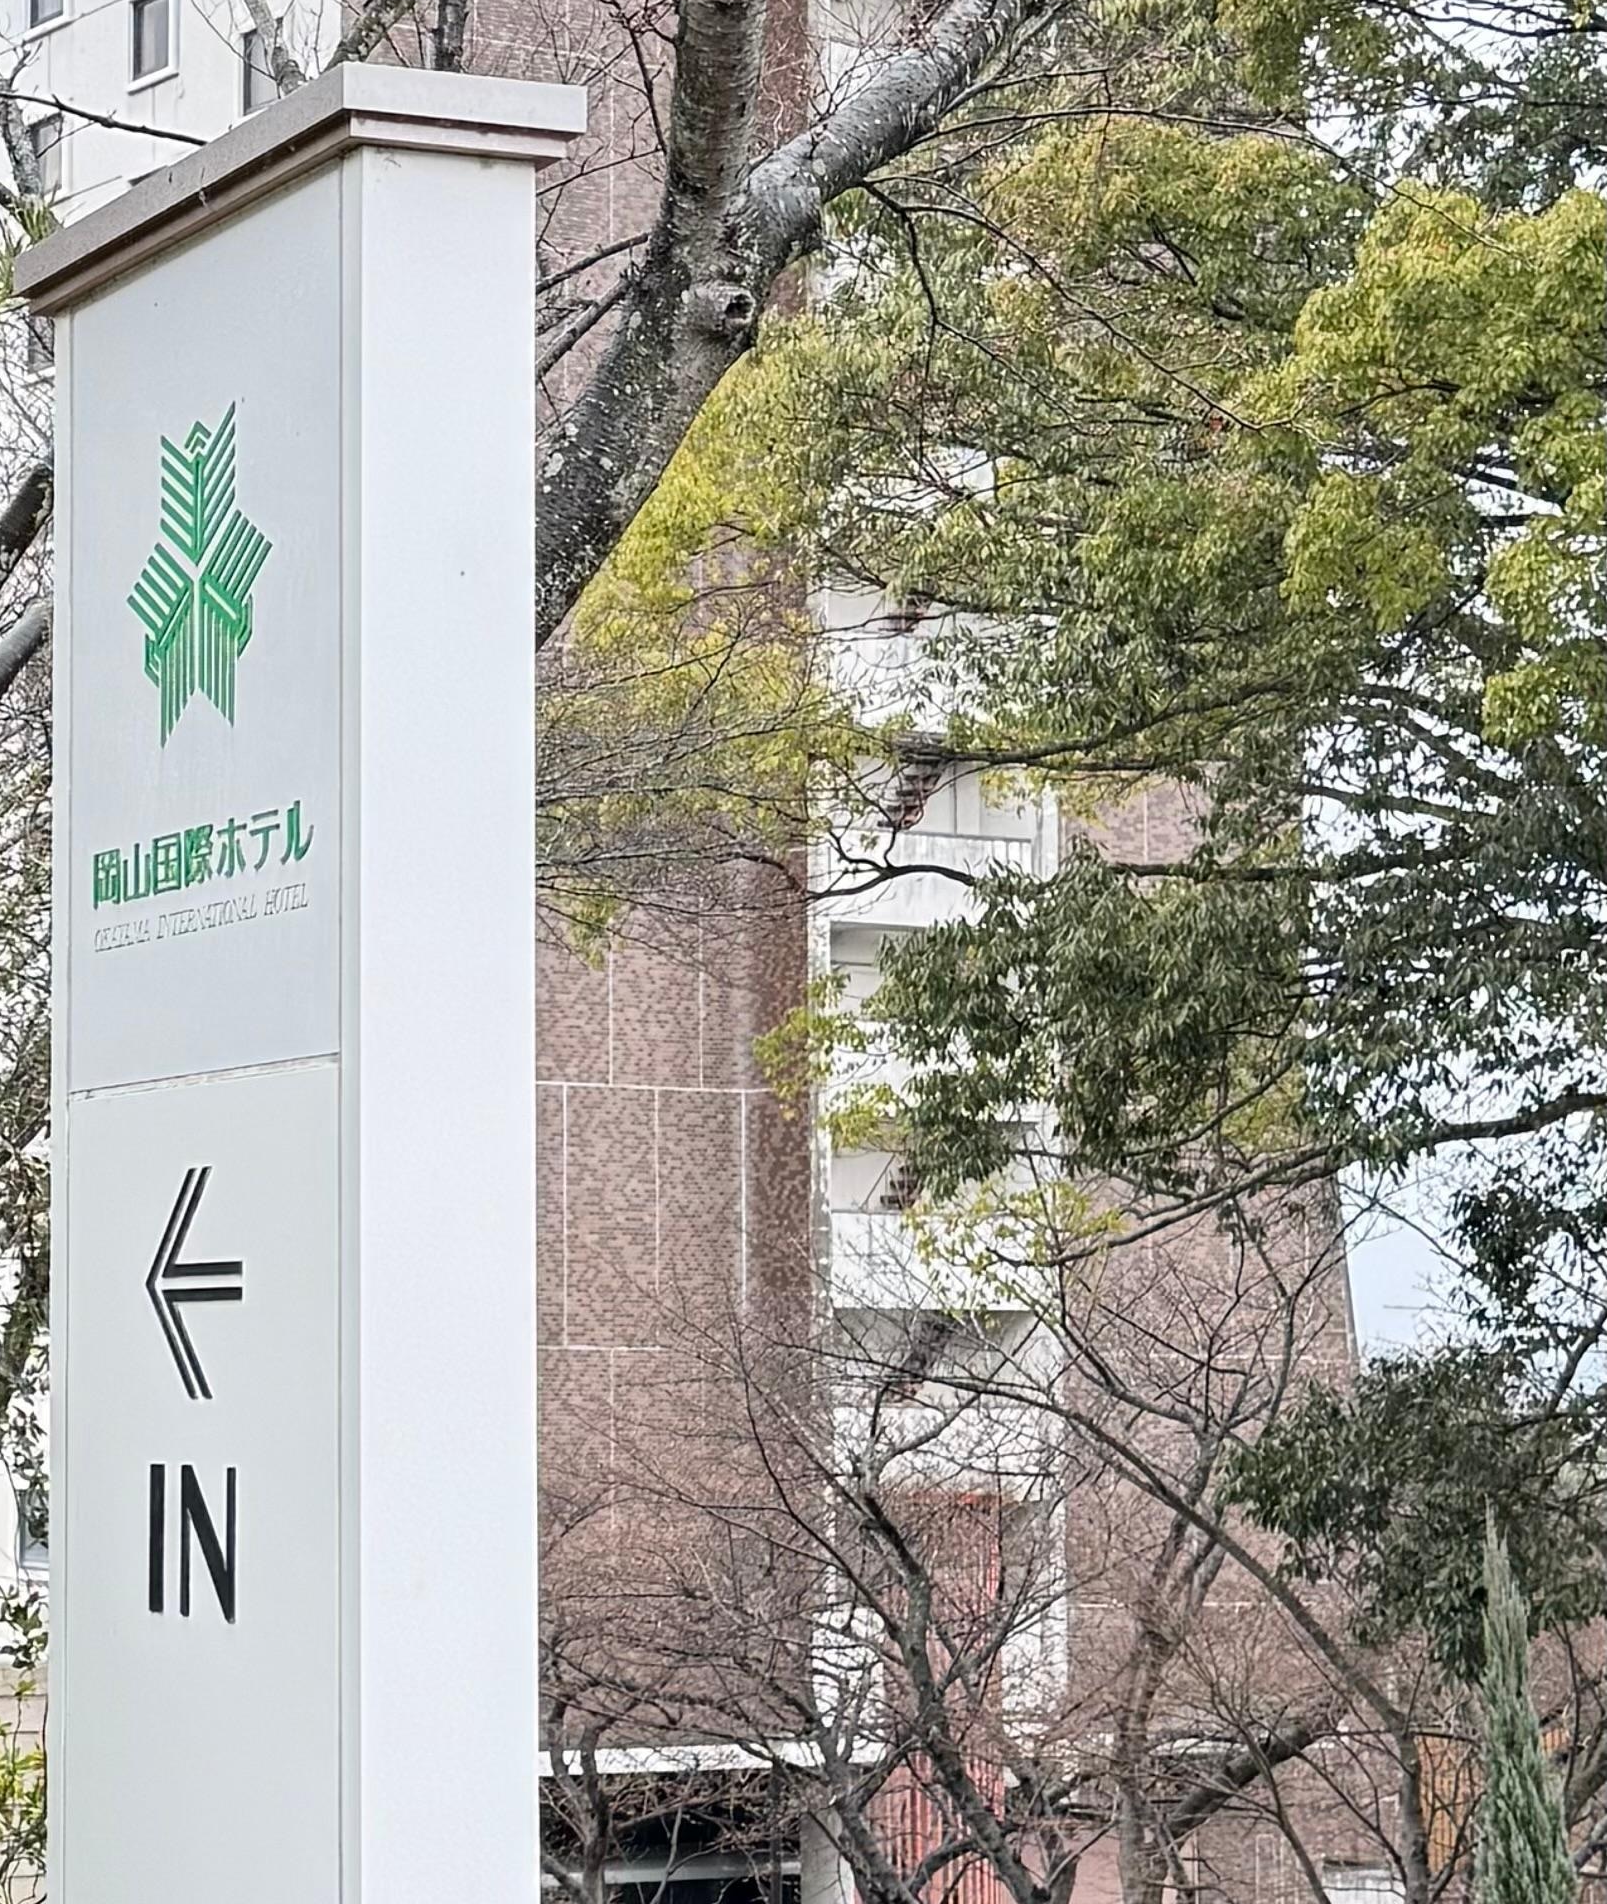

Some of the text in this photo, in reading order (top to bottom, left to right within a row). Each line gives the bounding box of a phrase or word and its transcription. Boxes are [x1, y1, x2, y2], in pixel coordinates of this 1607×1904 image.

[92, 799, 315, 911] 岡山国際ホテル
[156, 893, 257, 940] INTERNATIONAL
[263, 882, 310, 916] HOTEL
[148, 1463, 237, 1625] IN
